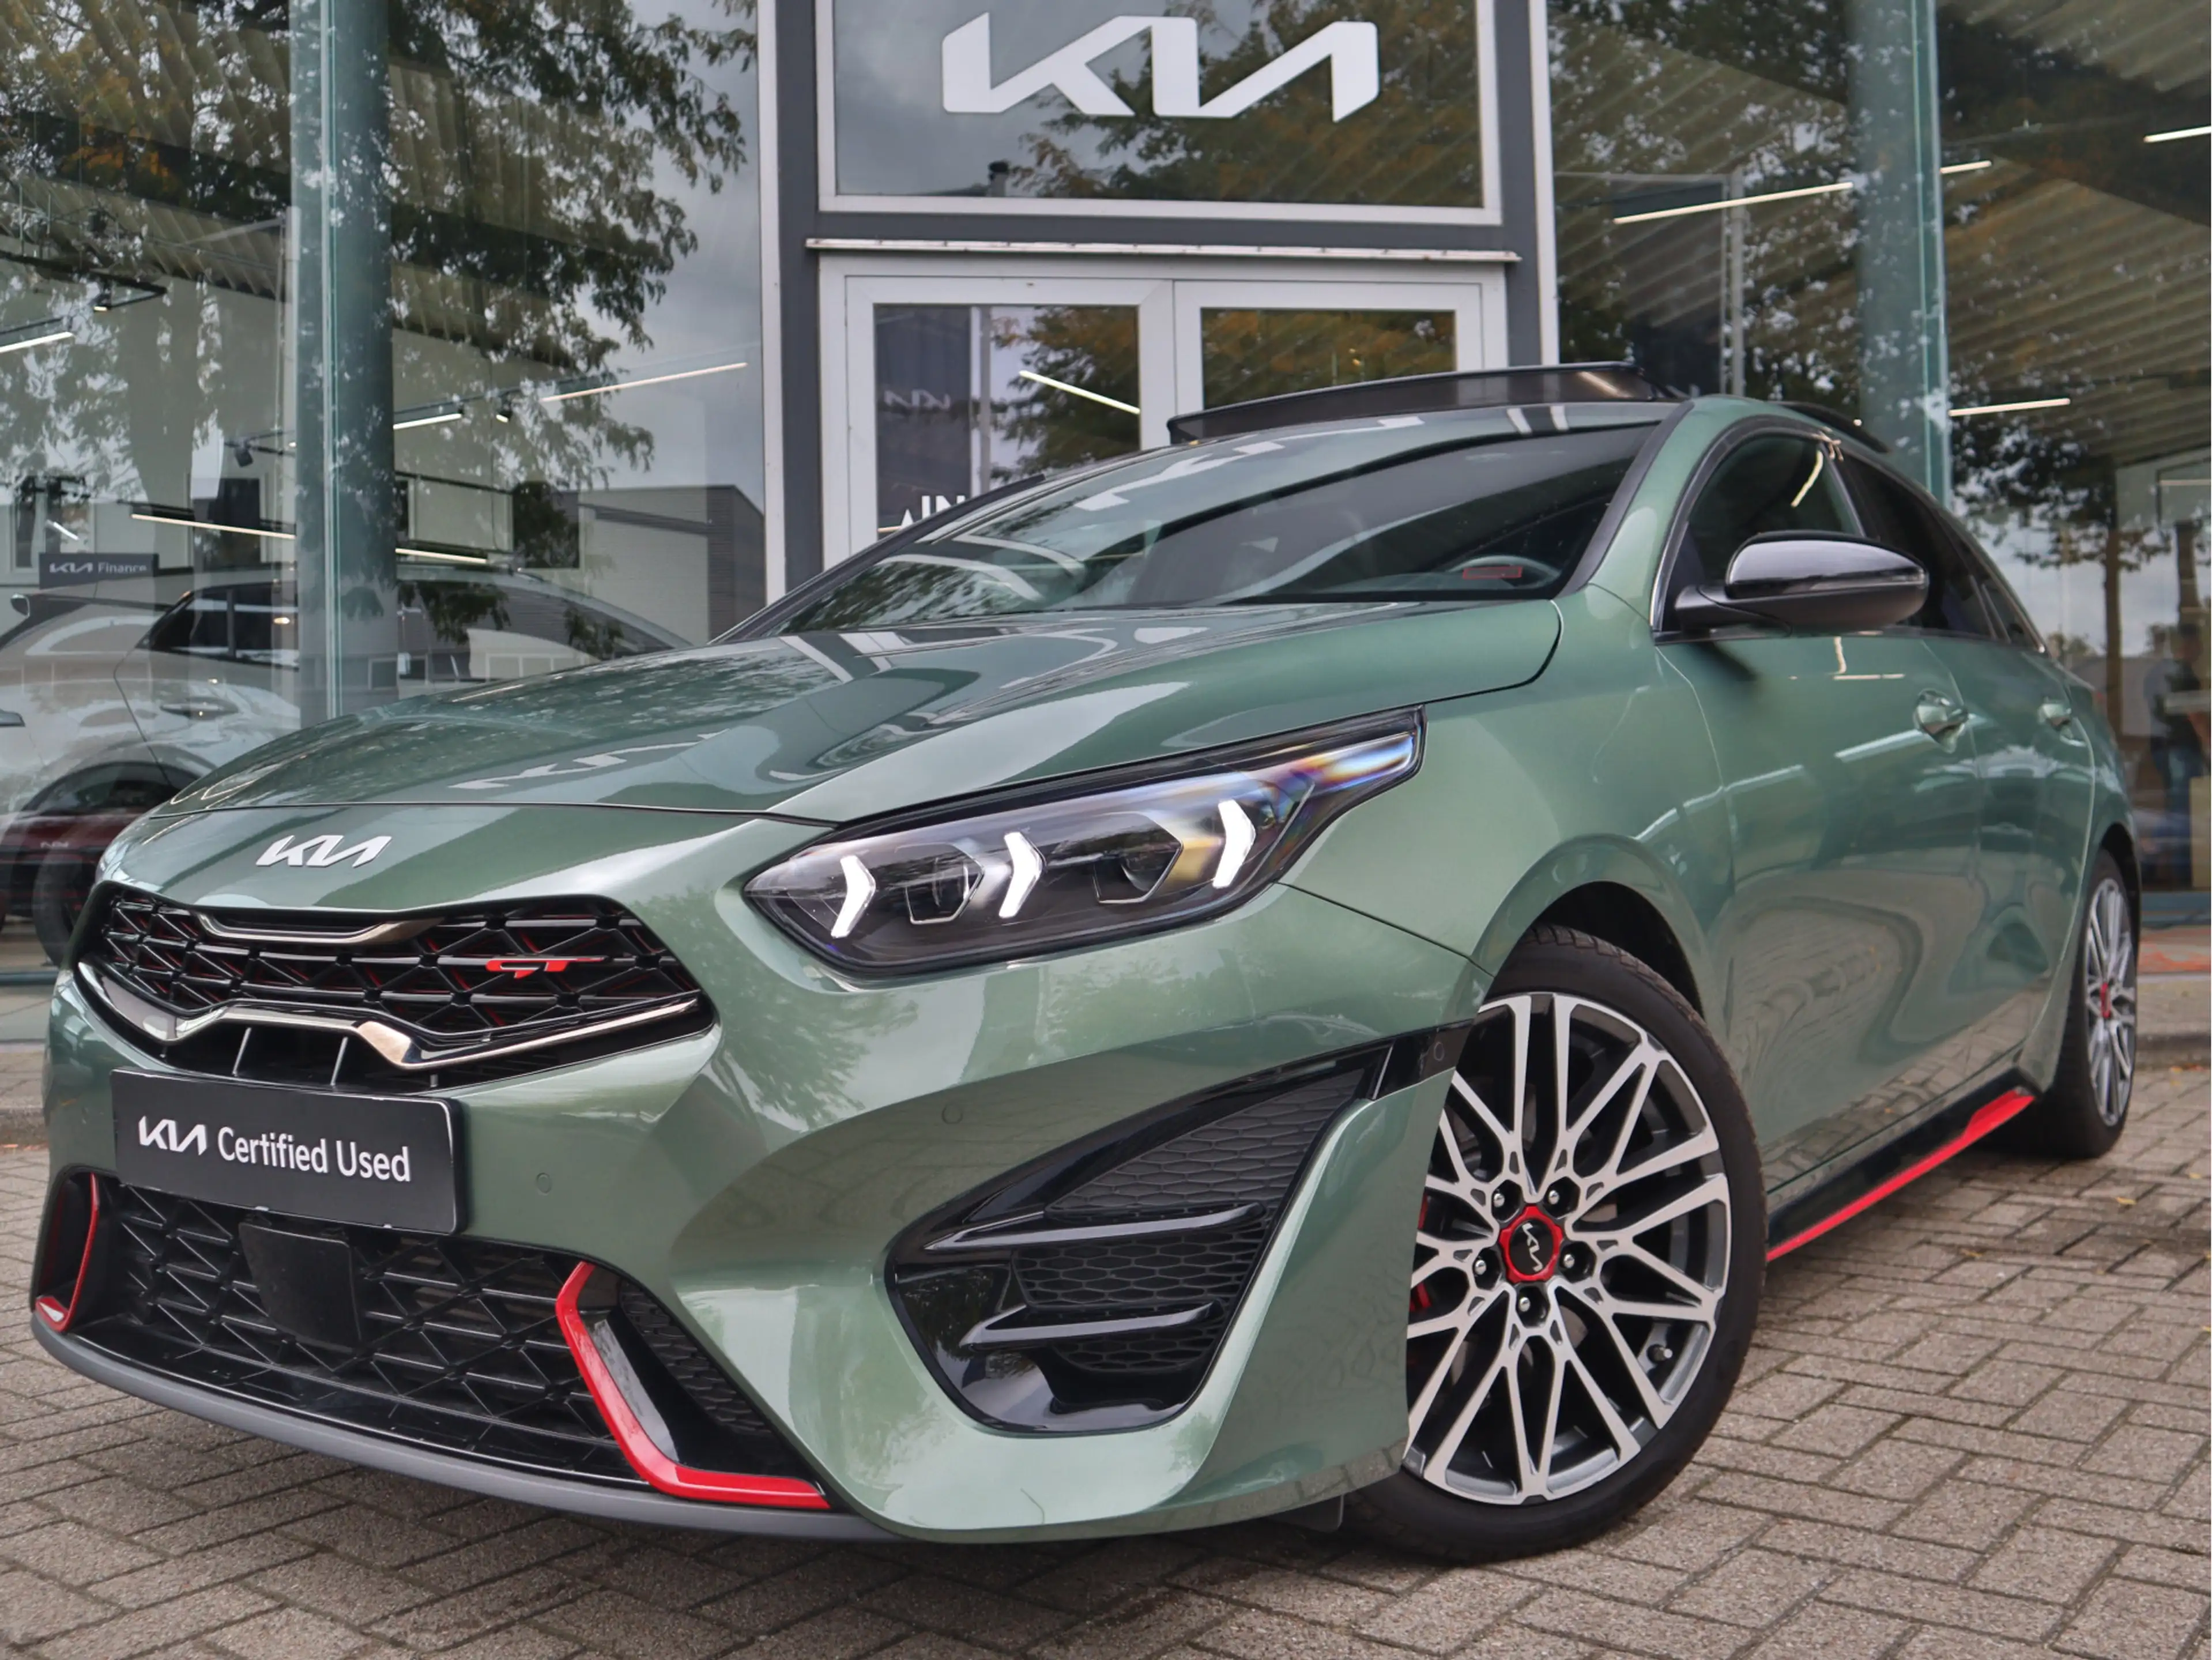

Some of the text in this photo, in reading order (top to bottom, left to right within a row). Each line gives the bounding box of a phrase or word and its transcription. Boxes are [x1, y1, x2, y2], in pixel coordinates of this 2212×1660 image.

[942, 12, 1380, 123] KIA
[49, 561, 147, 574] KIA Finance
[255, 835, 392, 869] KIA
[485, 956, 607, 979] GT
[138, 1115, 411, 1182] KIA Certified Used
[1522, 1222, 1543, 1272] KIA
